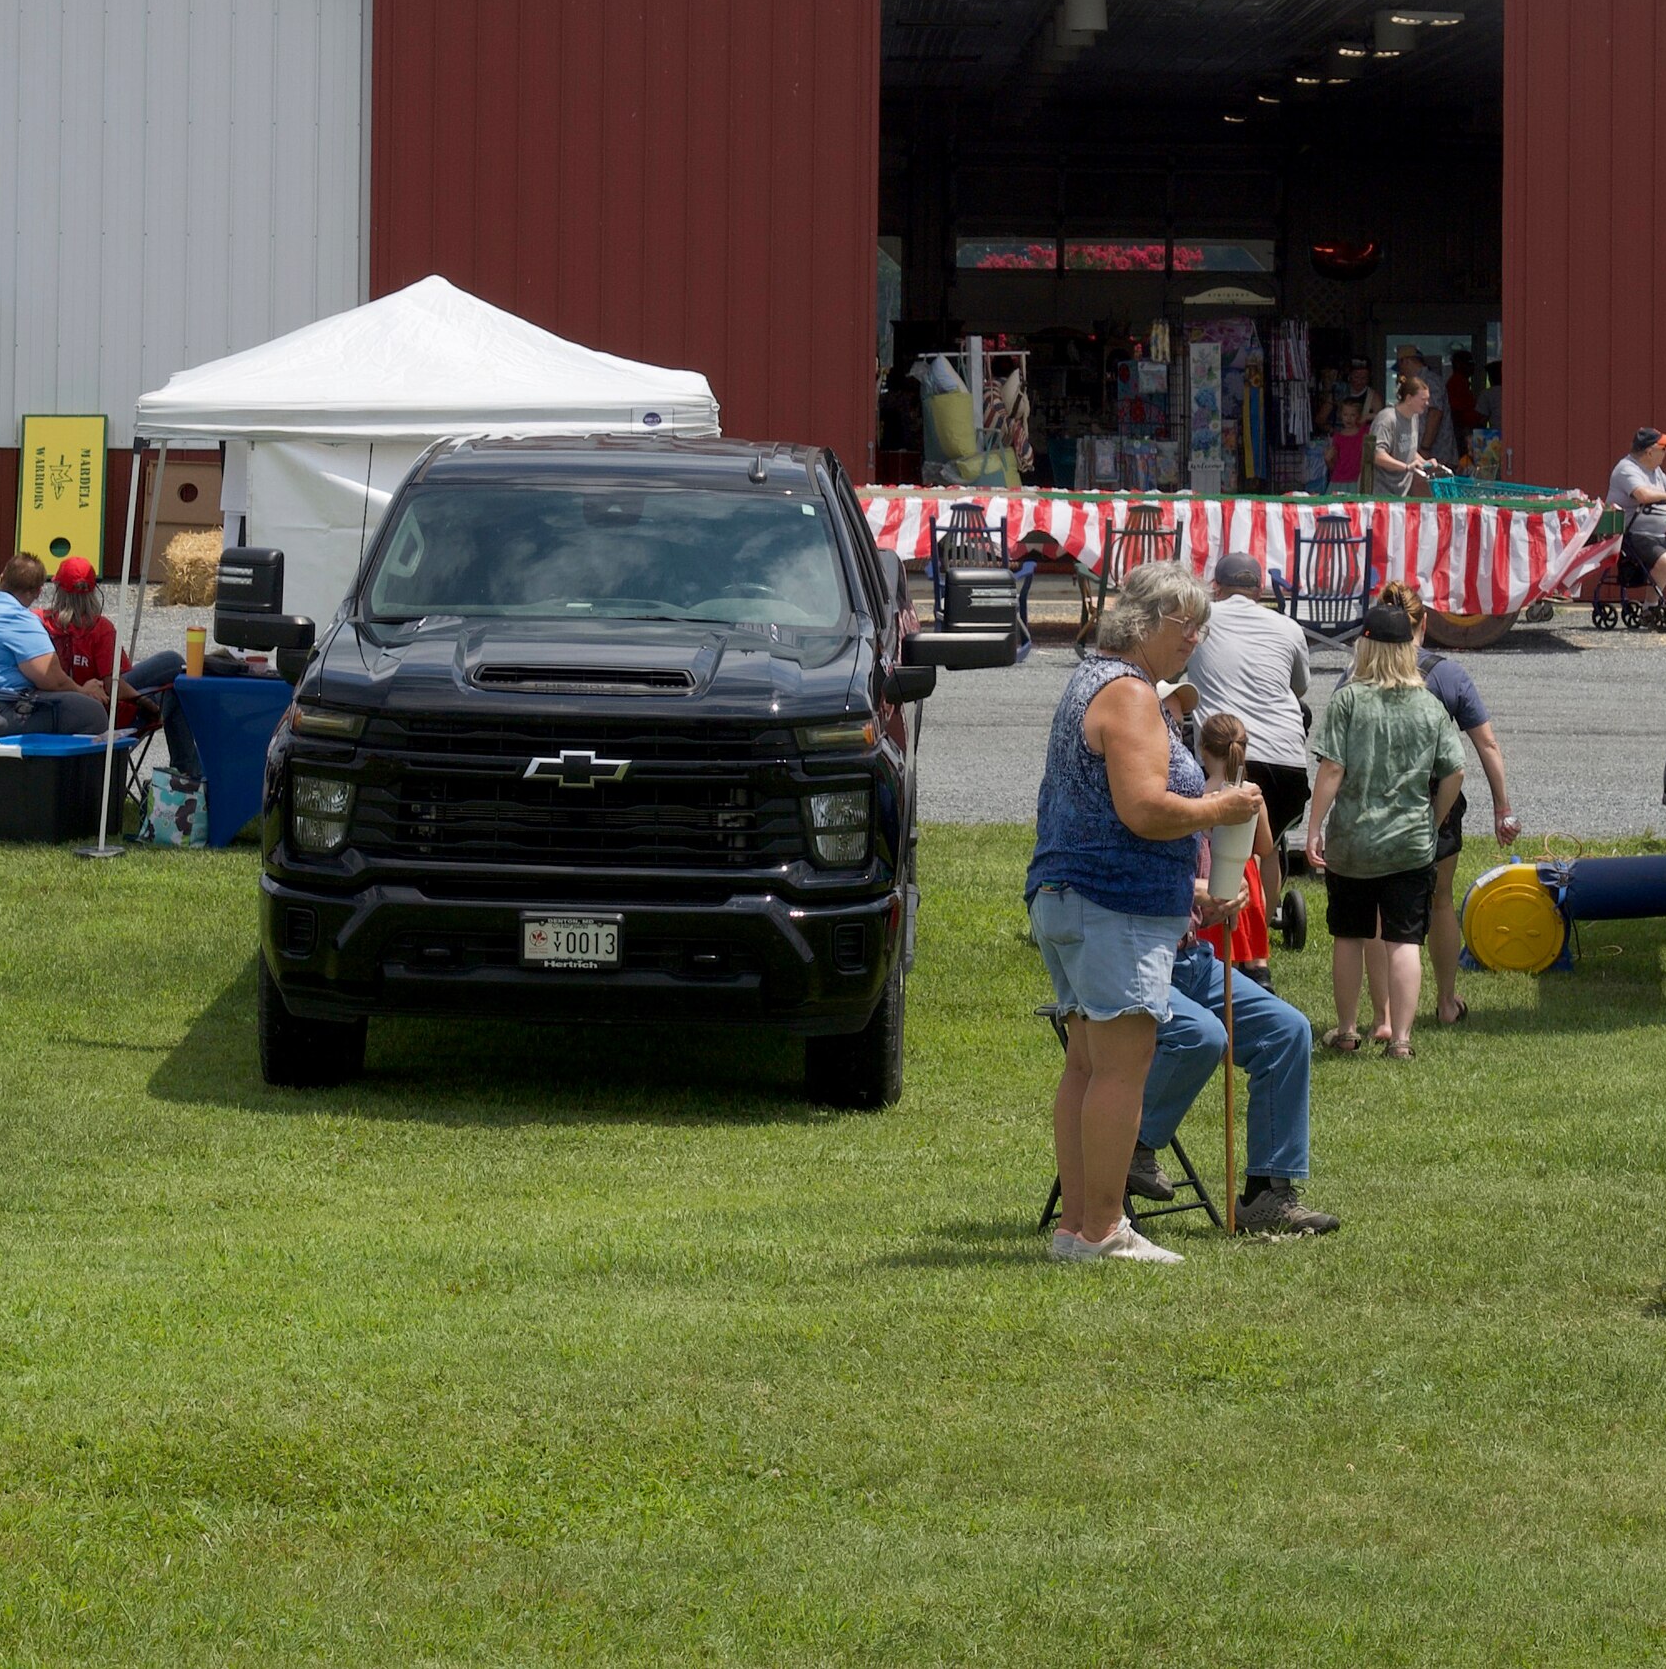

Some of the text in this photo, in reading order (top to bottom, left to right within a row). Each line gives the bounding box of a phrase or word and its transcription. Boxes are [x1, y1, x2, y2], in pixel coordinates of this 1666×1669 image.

[33, 446, 46, 511] WARRIORS
[78, 447, 92, 509] MARDELA
[543, 960, 598, 968] Hertrich
[566, 931, 616, 955] 0013
